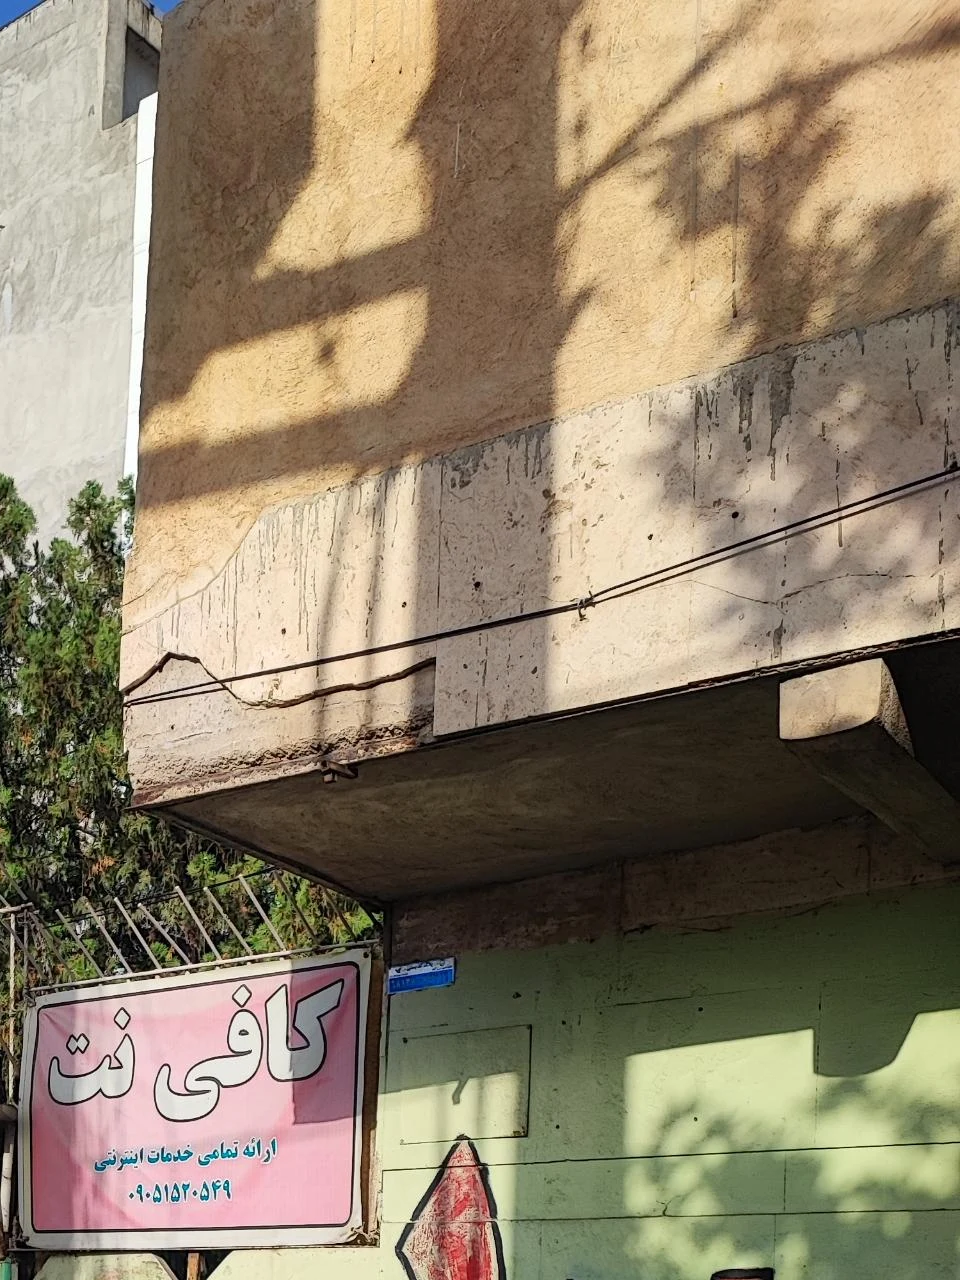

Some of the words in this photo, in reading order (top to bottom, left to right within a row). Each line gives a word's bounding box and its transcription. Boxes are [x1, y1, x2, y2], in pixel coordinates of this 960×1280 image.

[47, 1006, 136, 1106] نت
[153, 978, 345, 1123] کافی
[94, 1147, 144, 1172] اینترنتی
[147, 1144, 194, 1164] خدمات
[198, 1141, 239, 1166] تمامی
[242, 1137, 279, 1163] ارائه
[128, 1179, 232, 1204] ۰۹۰۵۱۵۲۰۵۴۹
